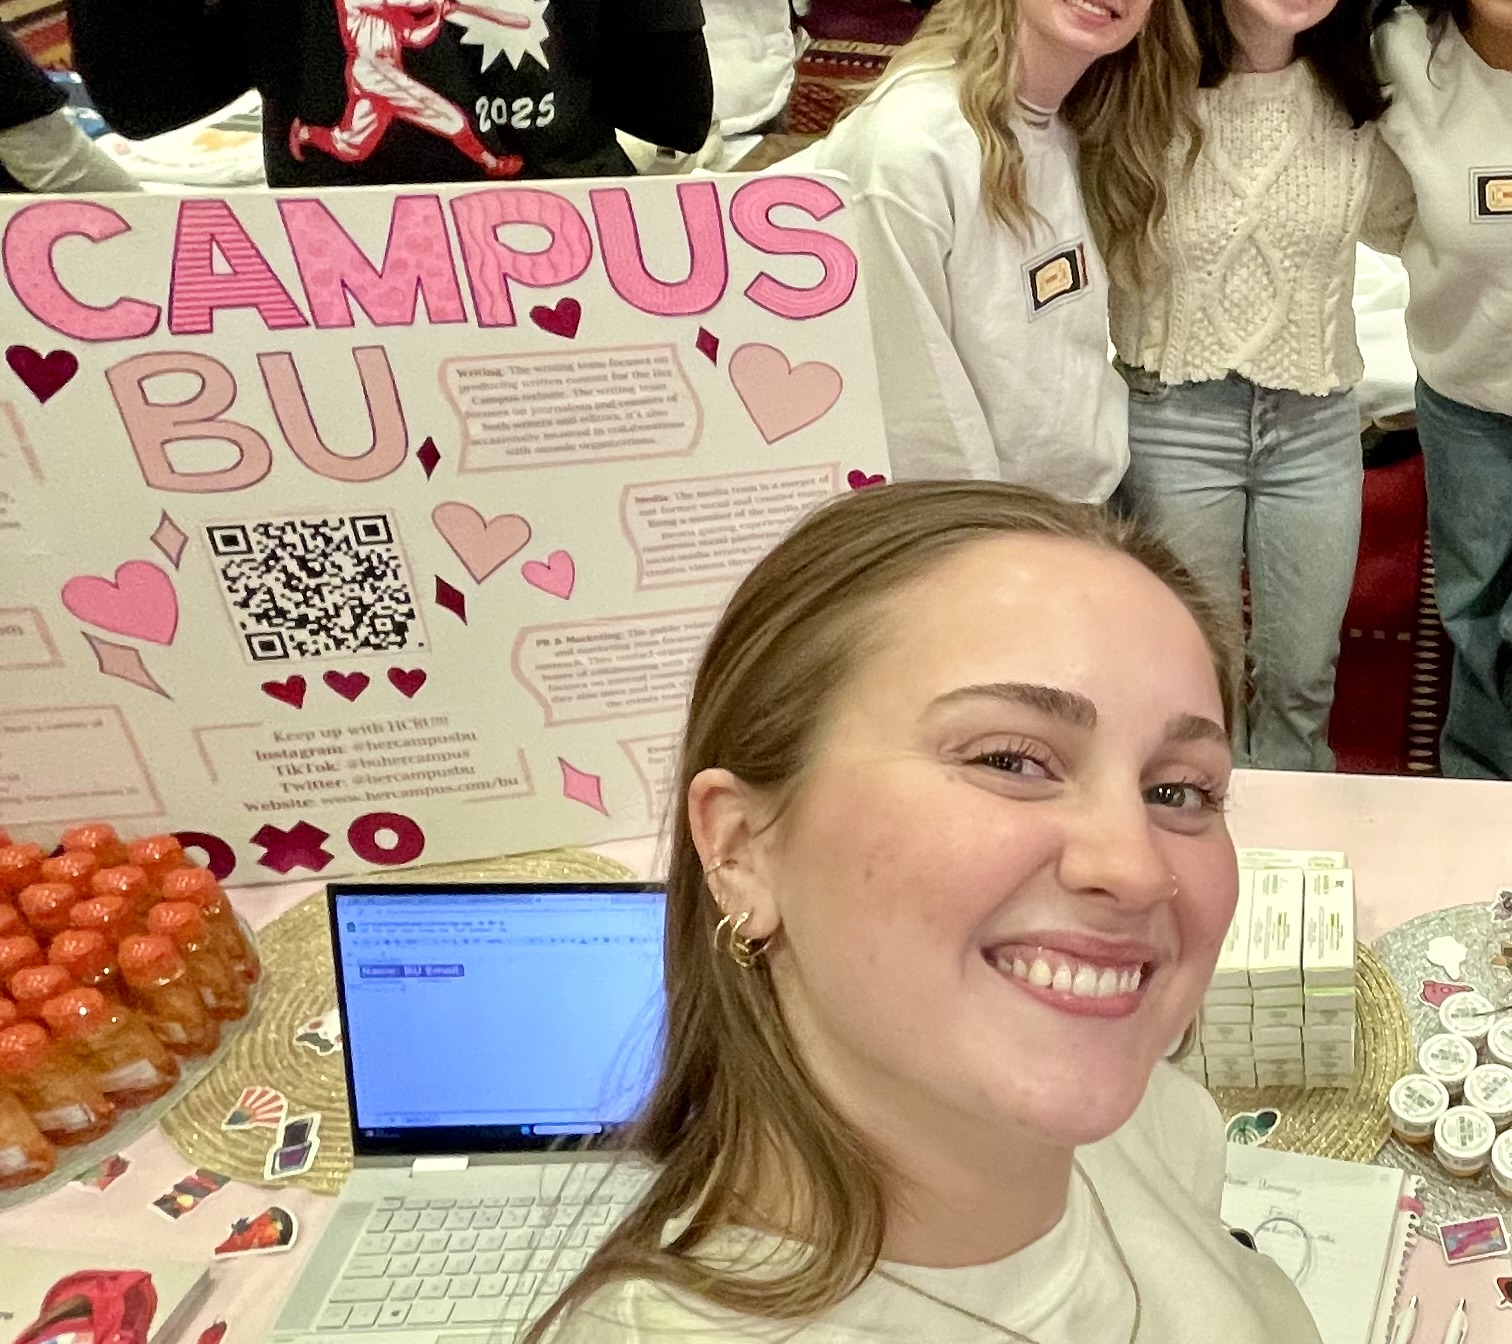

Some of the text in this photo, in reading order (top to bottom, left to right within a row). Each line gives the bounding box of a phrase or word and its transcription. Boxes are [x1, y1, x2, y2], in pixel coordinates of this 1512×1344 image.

[476, 92, 556, 132] 2025
[2, 175, 859, 343] CAMPUS
[105, 345, 410, 494] BU
